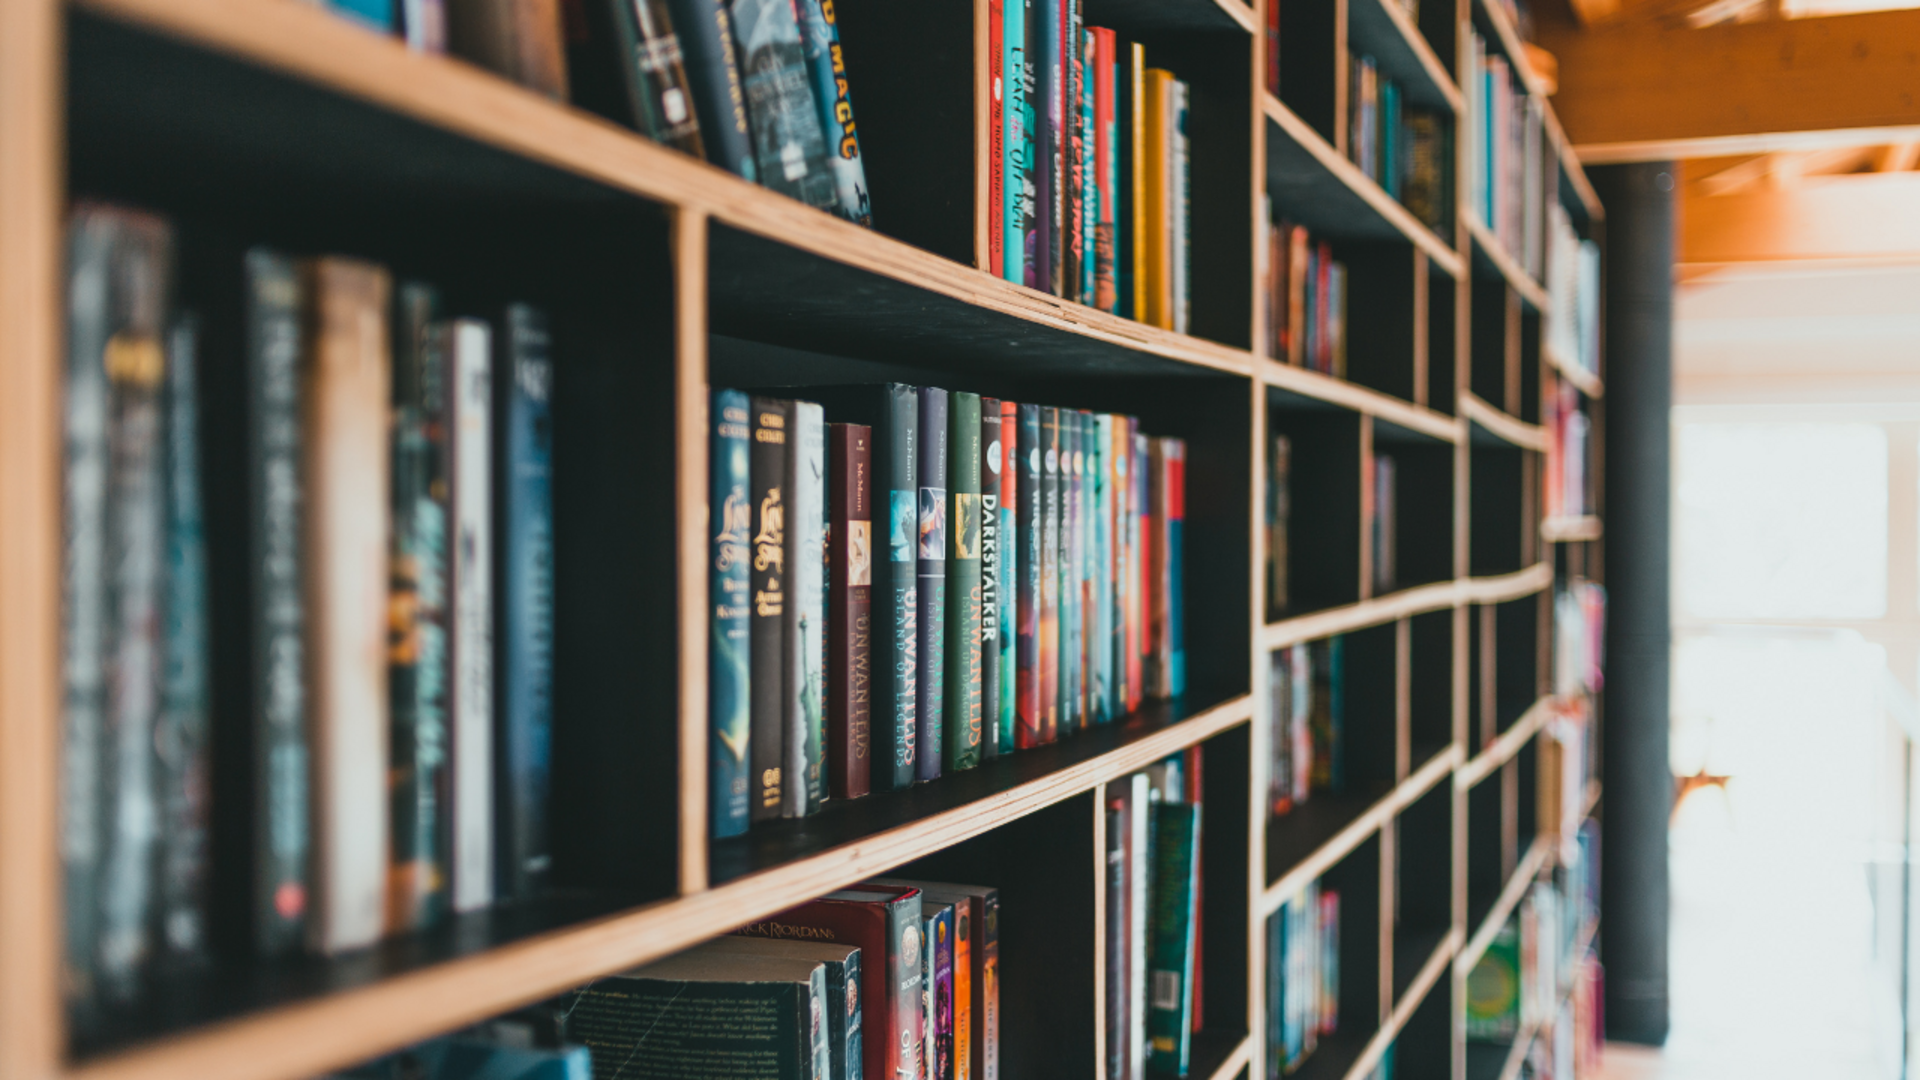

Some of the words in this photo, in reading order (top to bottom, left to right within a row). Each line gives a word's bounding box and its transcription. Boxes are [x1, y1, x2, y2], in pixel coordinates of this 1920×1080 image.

[828, 41, 858, 160] MAGIC
[1071, 136, 1083, 193] LOVE
[1071, 197, 1083, 262] STORY
[982, 494, 997, 642] DARKSTALKER
[896, 588, 905, 650] ISLAND
[962, 596, 970, 645] ISLAND
[856, 616, 870, 759] UNWANTEDS
[896, 662, 905, 680] OF
[904, 590, 917, 765] UNWANTEDS
[928, 659, 935, 674] OF
[934, 586, 945, 754] UNWANTEDS
[962, 652, 970, 665] OF
[969, 585, 982, 746] UNWANTEDS
[896, 692, 905, 767] LEGENDS
[926, 682, 935, 737] GRAVES
[962, 674, 970, 736] DRAGONS
[900, 1028, 912, 1059] OF
